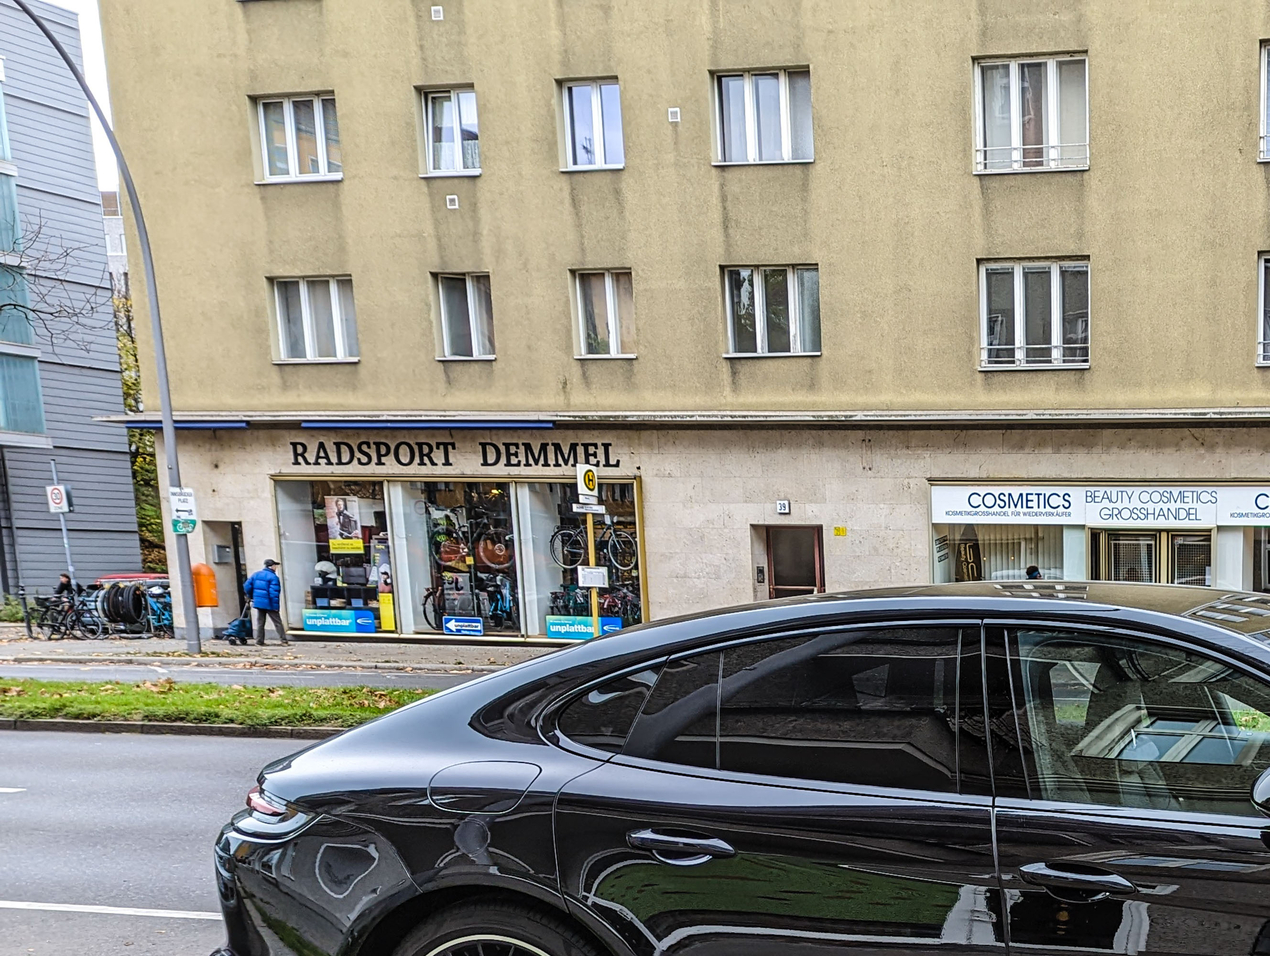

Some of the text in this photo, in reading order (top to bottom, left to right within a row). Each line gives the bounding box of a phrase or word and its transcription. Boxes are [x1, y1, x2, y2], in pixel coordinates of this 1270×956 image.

[290, 441, 620, 467] RADSPORT DEMMEL
[968, 492, 1071, 509] COSMETICS
[1085, 490, 1217, 504] BEAUTY COSMETICS
[778, 503, 787, 511] 39
[1099, 507, 1202, 521] GROSSHANDEL
[306, 617, 351, 627] unplattbar
